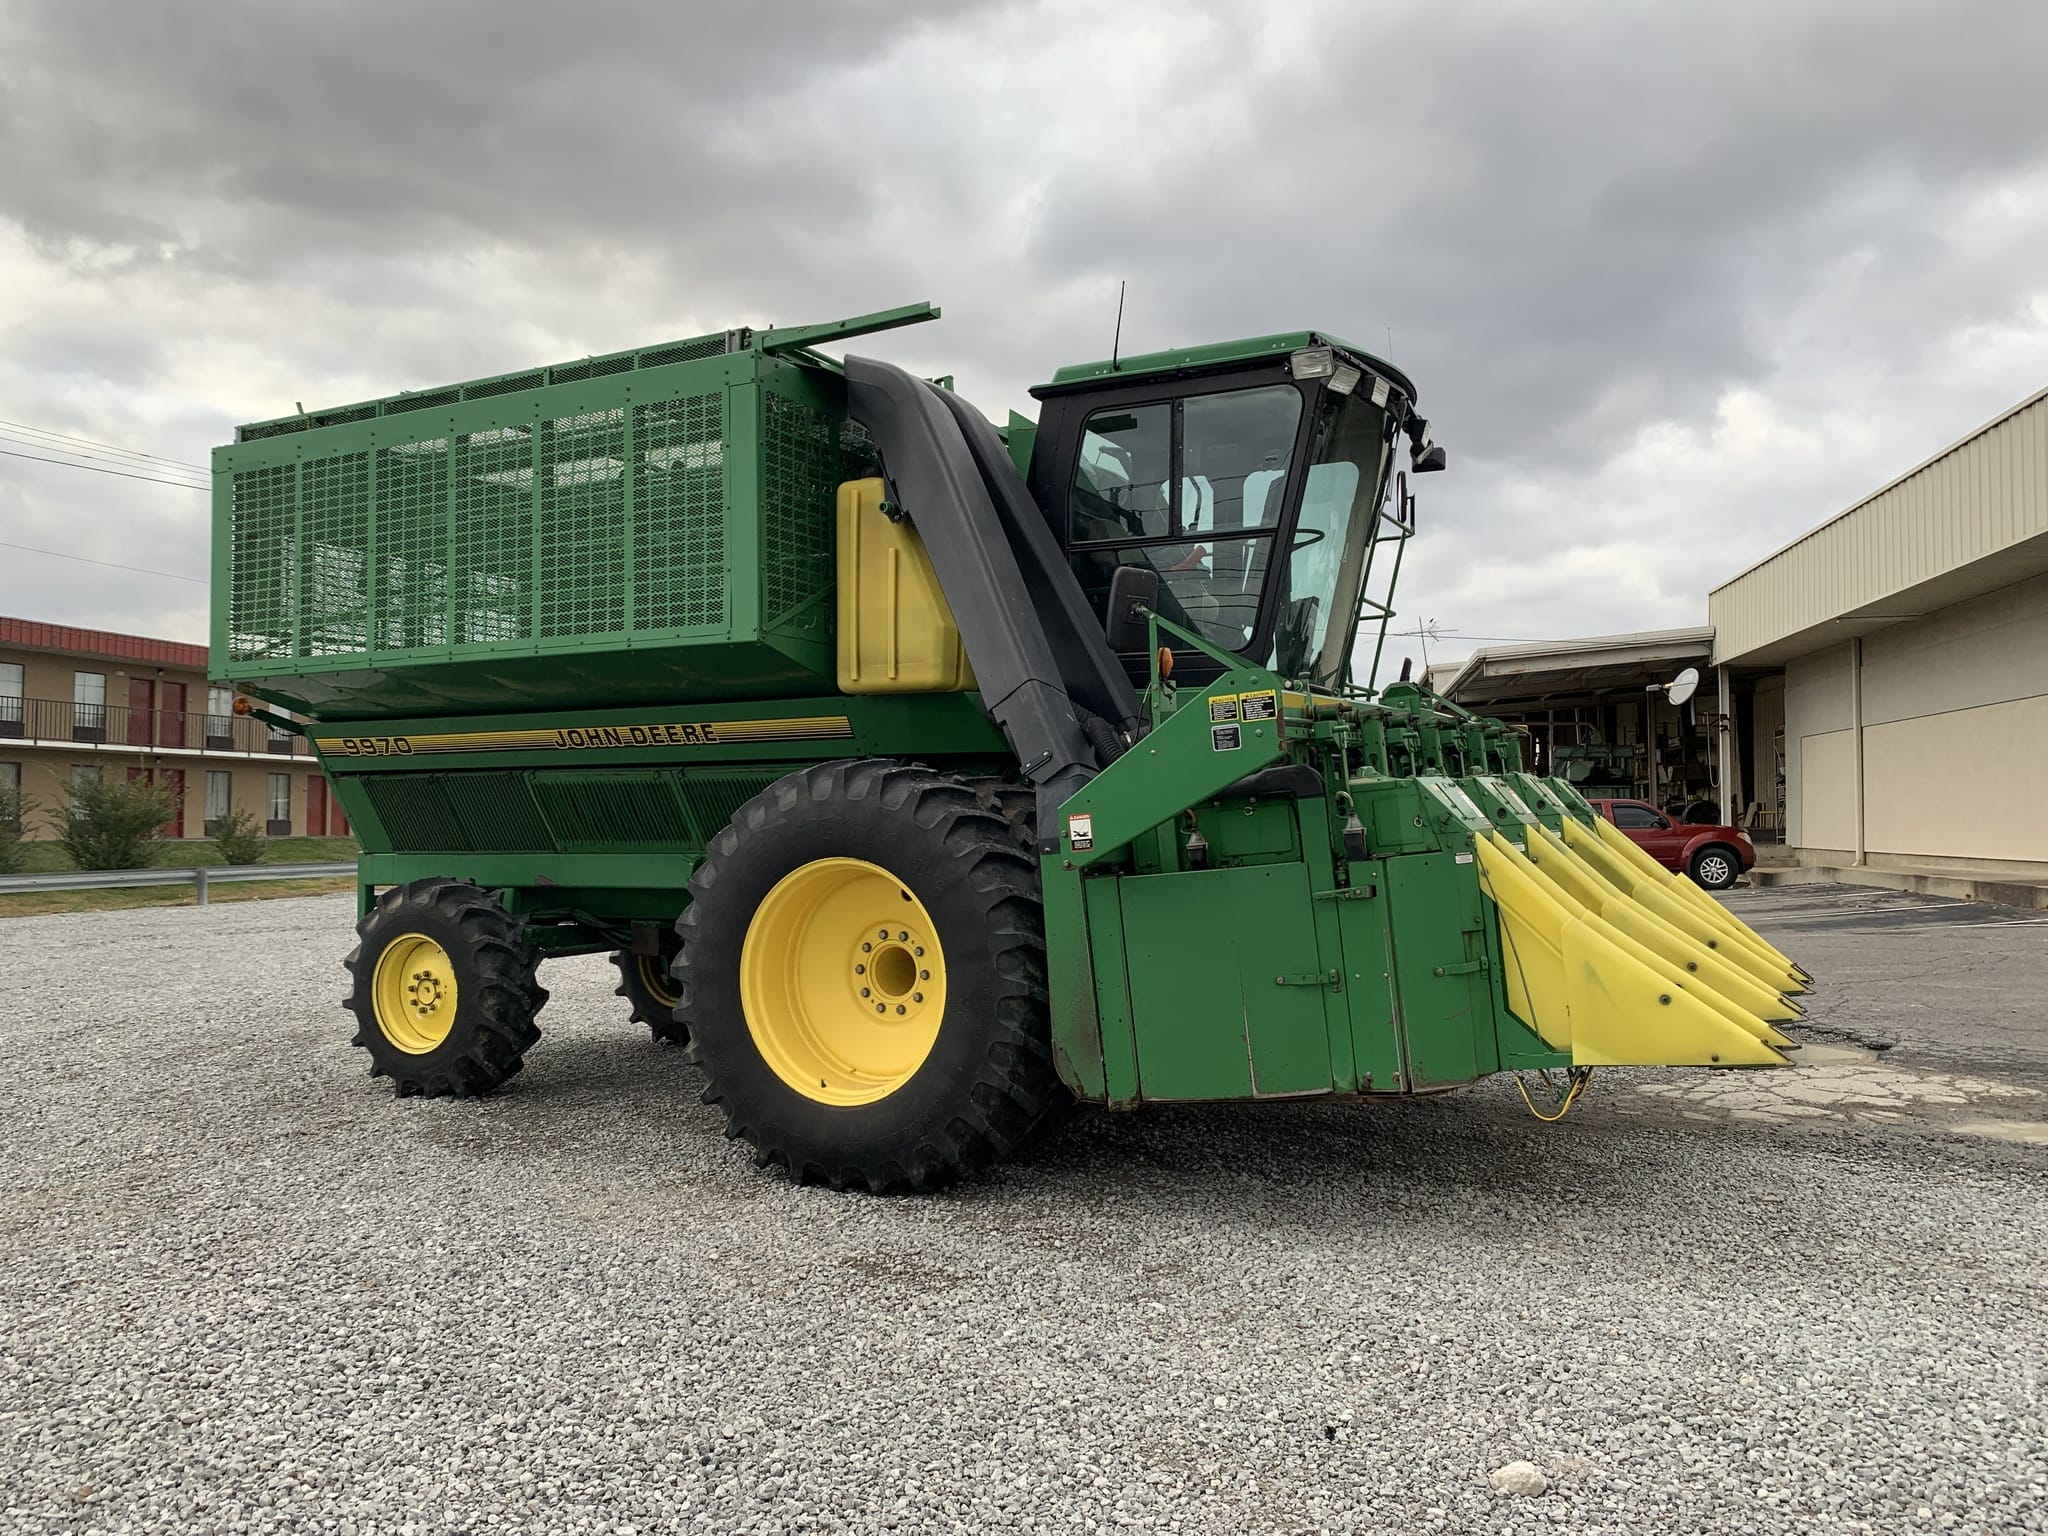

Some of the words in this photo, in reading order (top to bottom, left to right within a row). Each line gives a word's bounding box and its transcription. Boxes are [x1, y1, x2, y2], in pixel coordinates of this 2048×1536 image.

[342, 736, 414, 757] 9970
[554, 727, 624, 749] JOHN
[629, 723, 720, 746] DEERE
